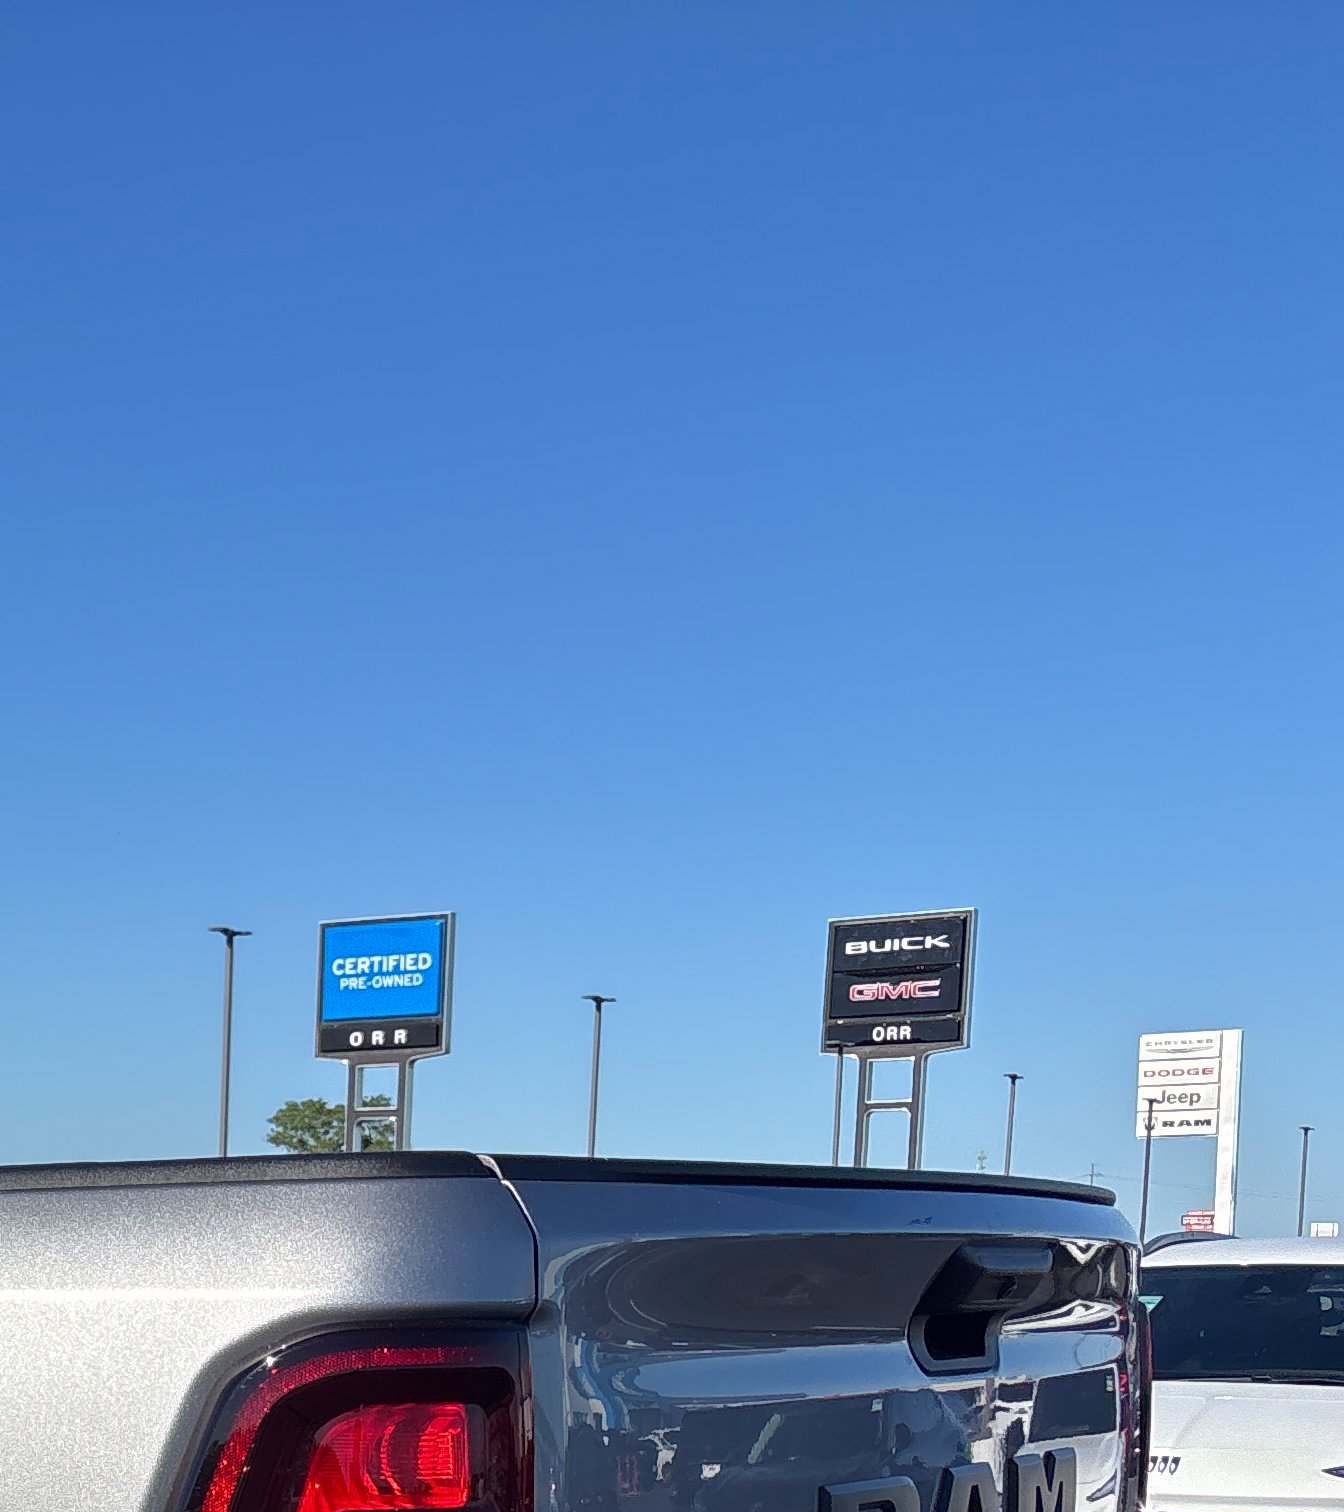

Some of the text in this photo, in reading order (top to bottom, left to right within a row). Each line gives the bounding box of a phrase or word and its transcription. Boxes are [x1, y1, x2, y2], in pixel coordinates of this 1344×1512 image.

[844, 934, 951, 955] BUICK
[331, 952, 433, 977] CERTIFIED
[339, 973, 424, 991] PRE-OWNED
[848, 978, 942, 1002] GMC
[872, 1025, 912, 1042] ORR
[1143, 1067, 1214, 1078] DODGE
[1159, 1089, 1202, 1107] Jeep
[1161, 1119, 1212, 1128] RAM
